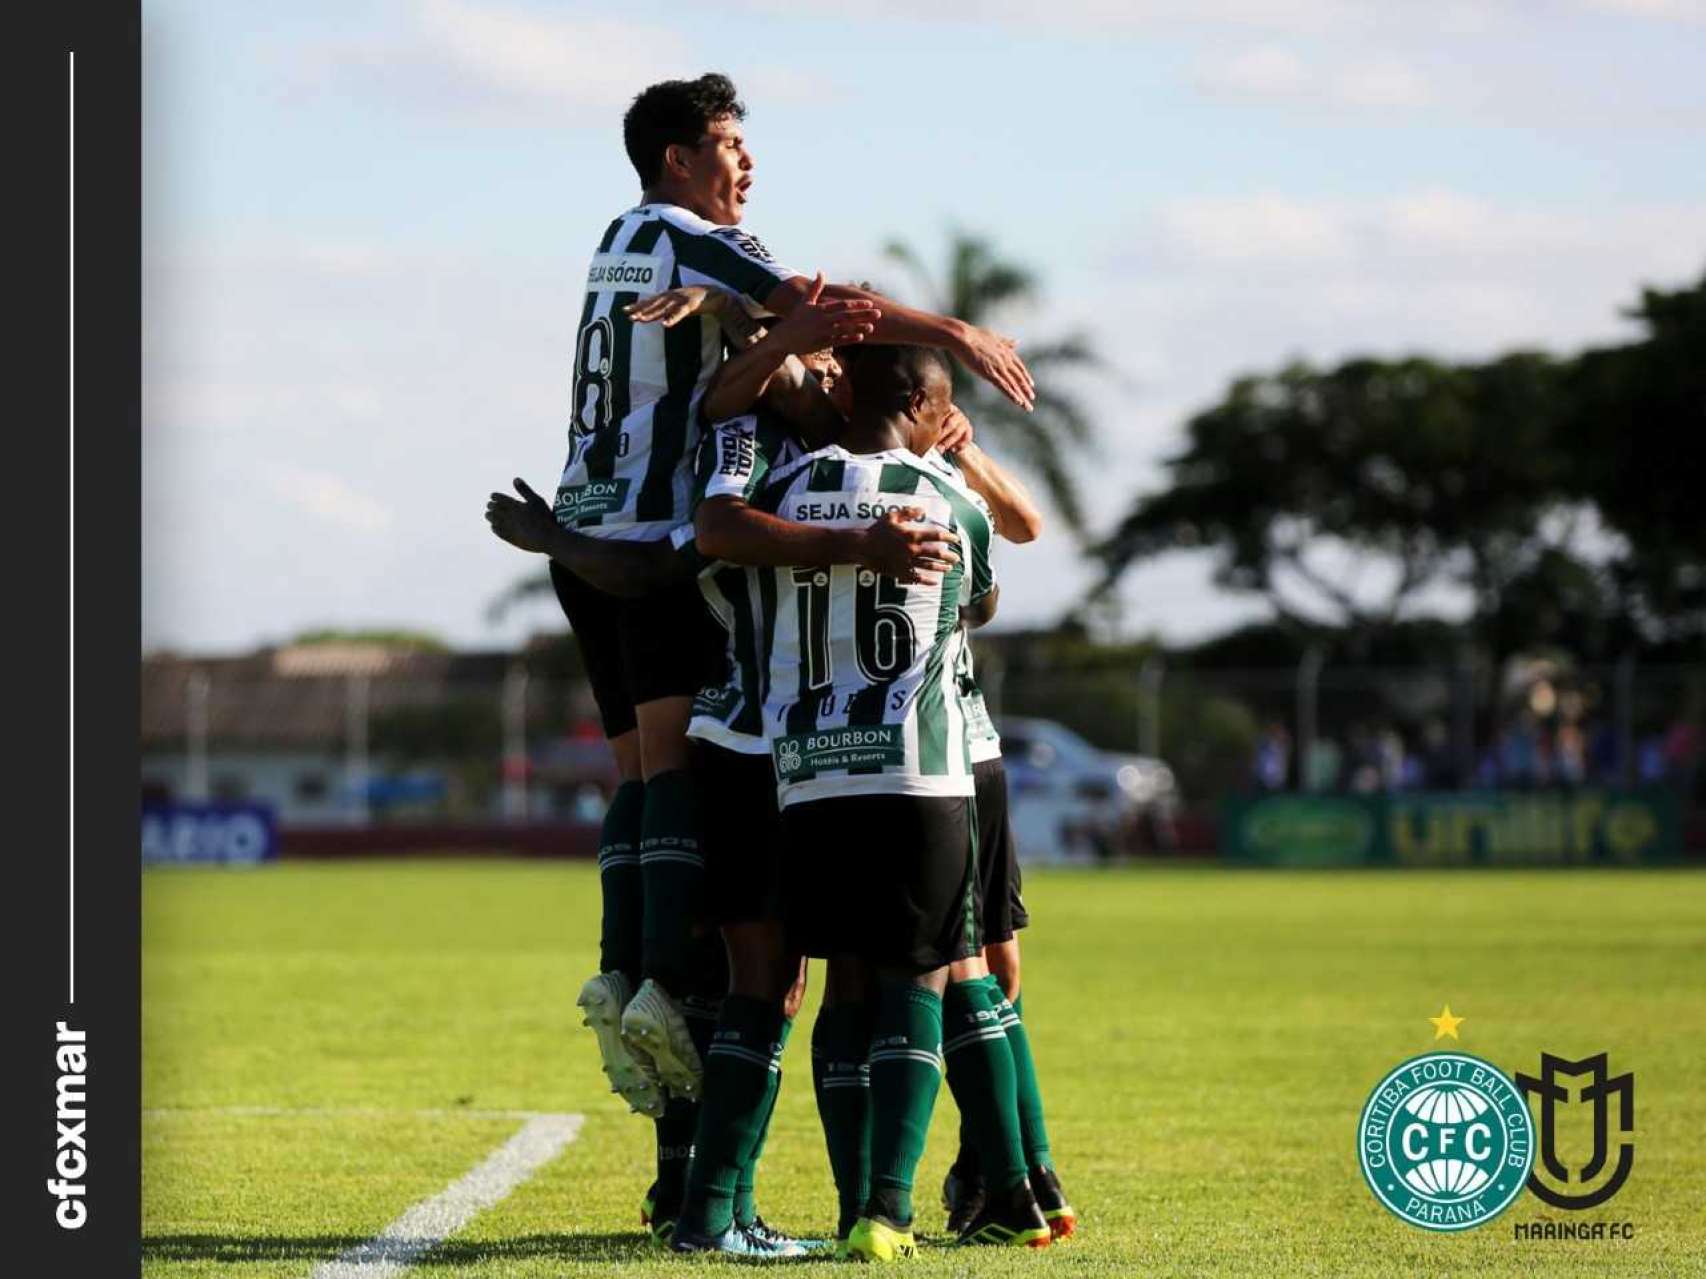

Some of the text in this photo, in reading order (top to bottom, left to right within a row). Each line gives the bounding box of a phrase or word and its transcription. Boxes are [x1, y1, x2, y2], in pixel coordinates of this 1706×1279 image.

[606, 261, 653, 284] SÓCIO
[571, 317, 614, 436] 8
[796, 503, 850, 521] SEJA
[791, 563, 916, 690] 16
[806, 730, 892, 751] BOURBON
